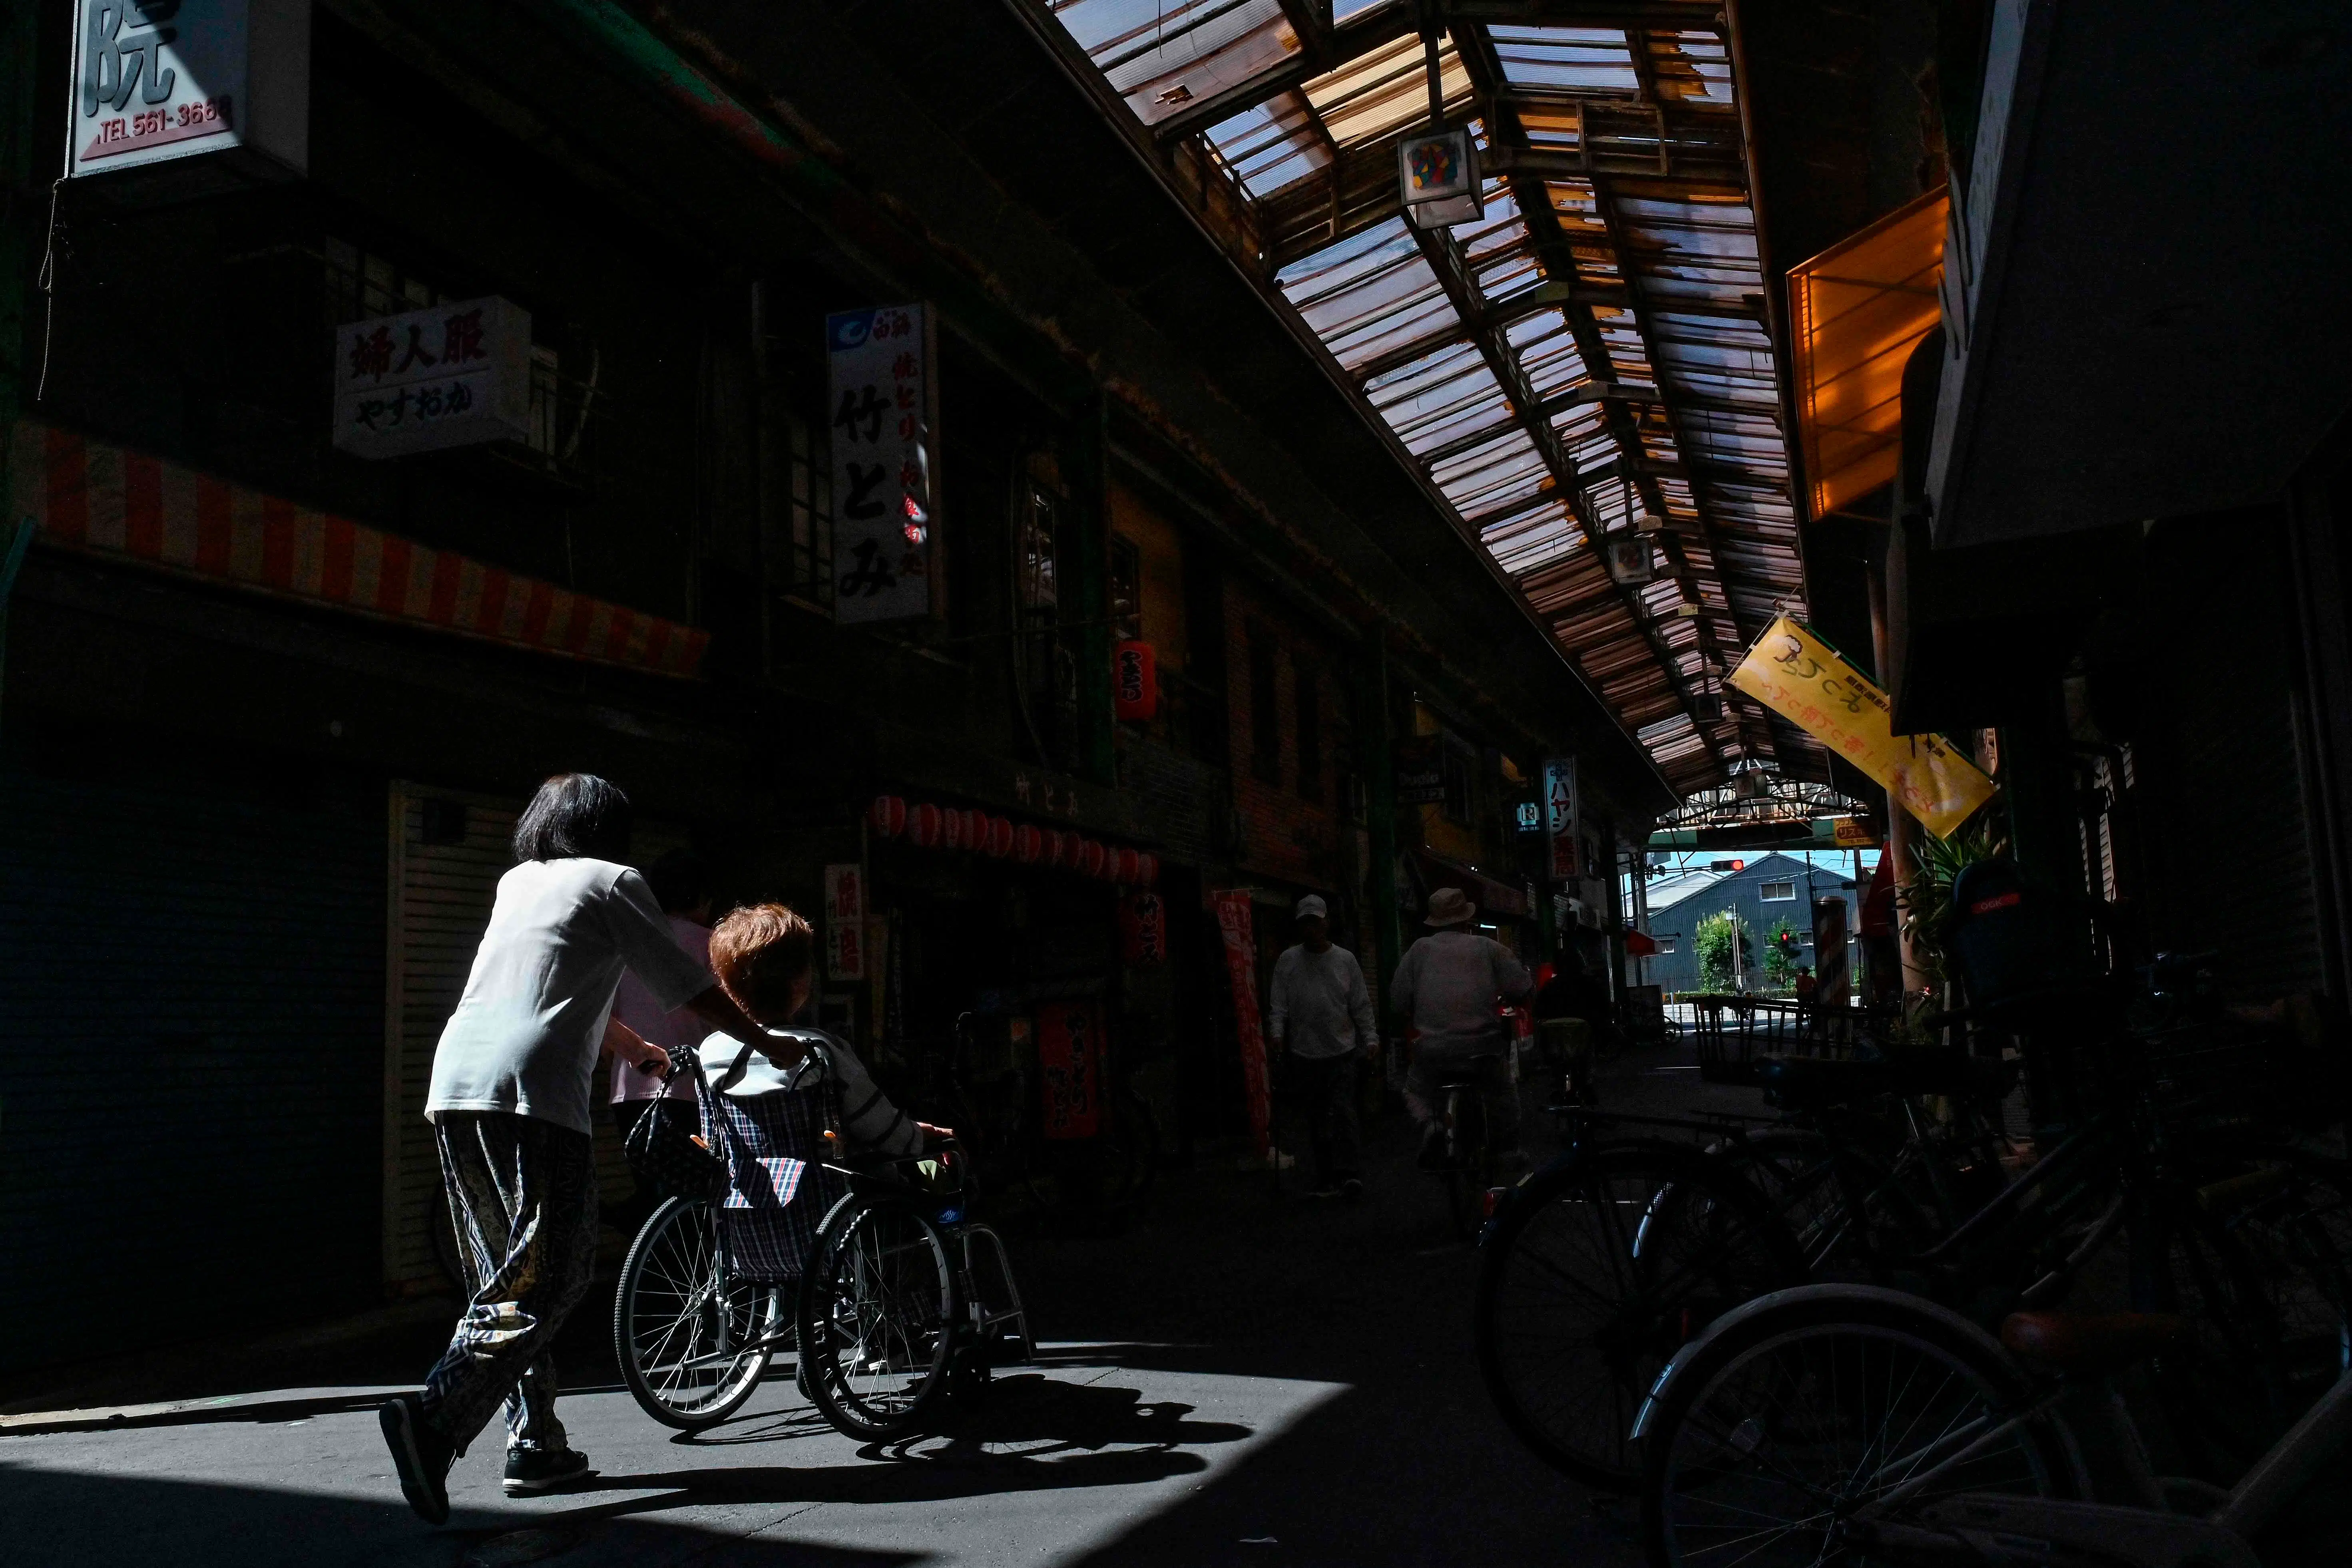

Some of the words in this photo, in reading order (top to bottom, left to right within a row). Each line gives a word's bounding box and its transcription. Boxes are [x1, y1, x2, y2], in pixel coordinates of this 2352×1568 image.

[99, 118, 129, 144] TEL
[350, 308, 487, 383] 婦人服
[834, 385, 896, 597] 竹とみ
[1980, 897, 2003, 911] OGK
